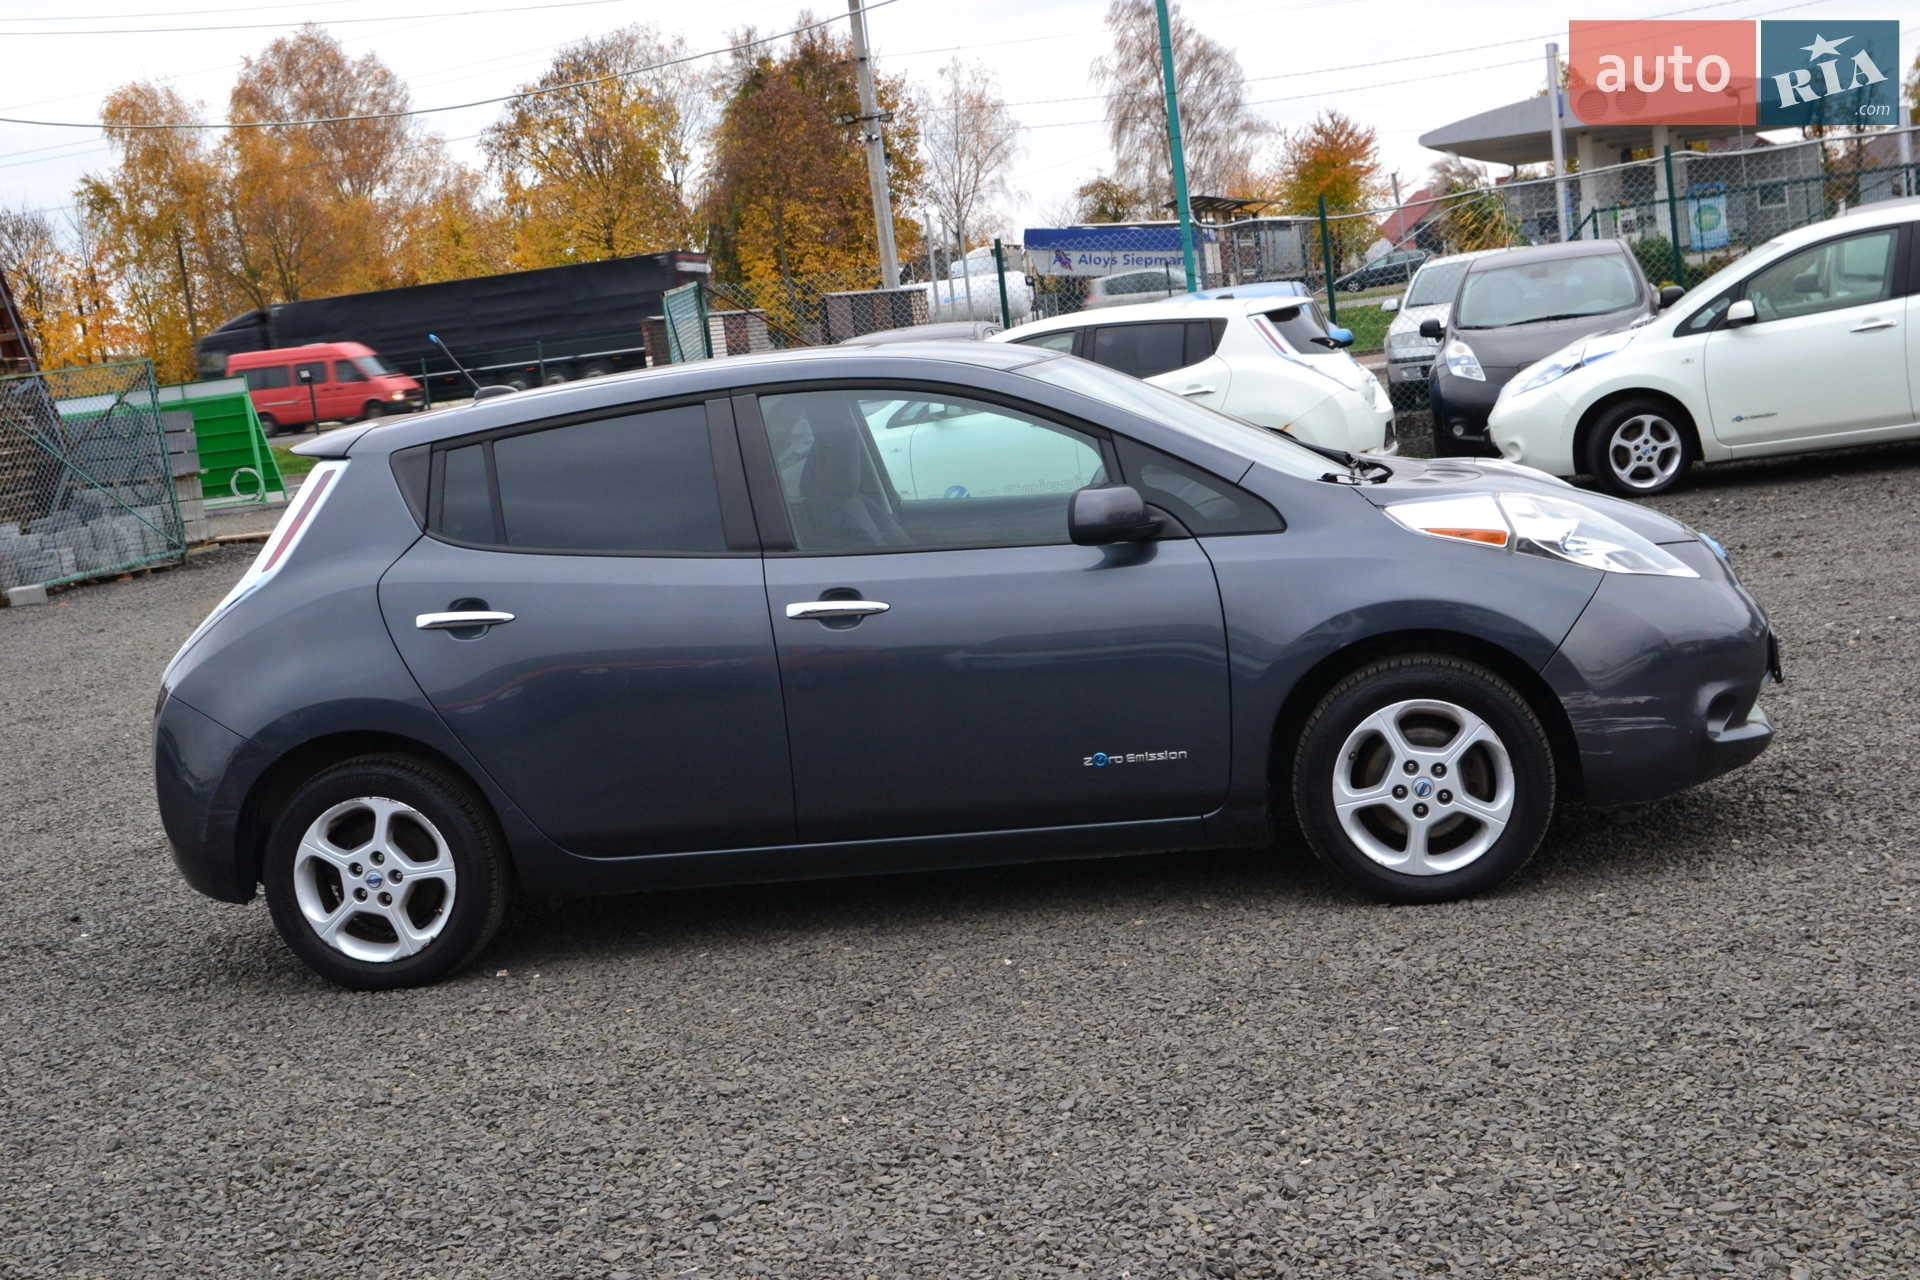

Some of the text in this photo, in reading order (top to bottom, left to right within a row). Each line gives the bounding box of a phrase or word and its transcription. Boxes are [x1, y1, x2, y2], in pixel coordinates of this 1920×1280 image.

[1078, 252, 1118, 268] Aloys
[1122, 252, 1195, 268] Siepman
[1126, 750, 1188, 763] Emission
